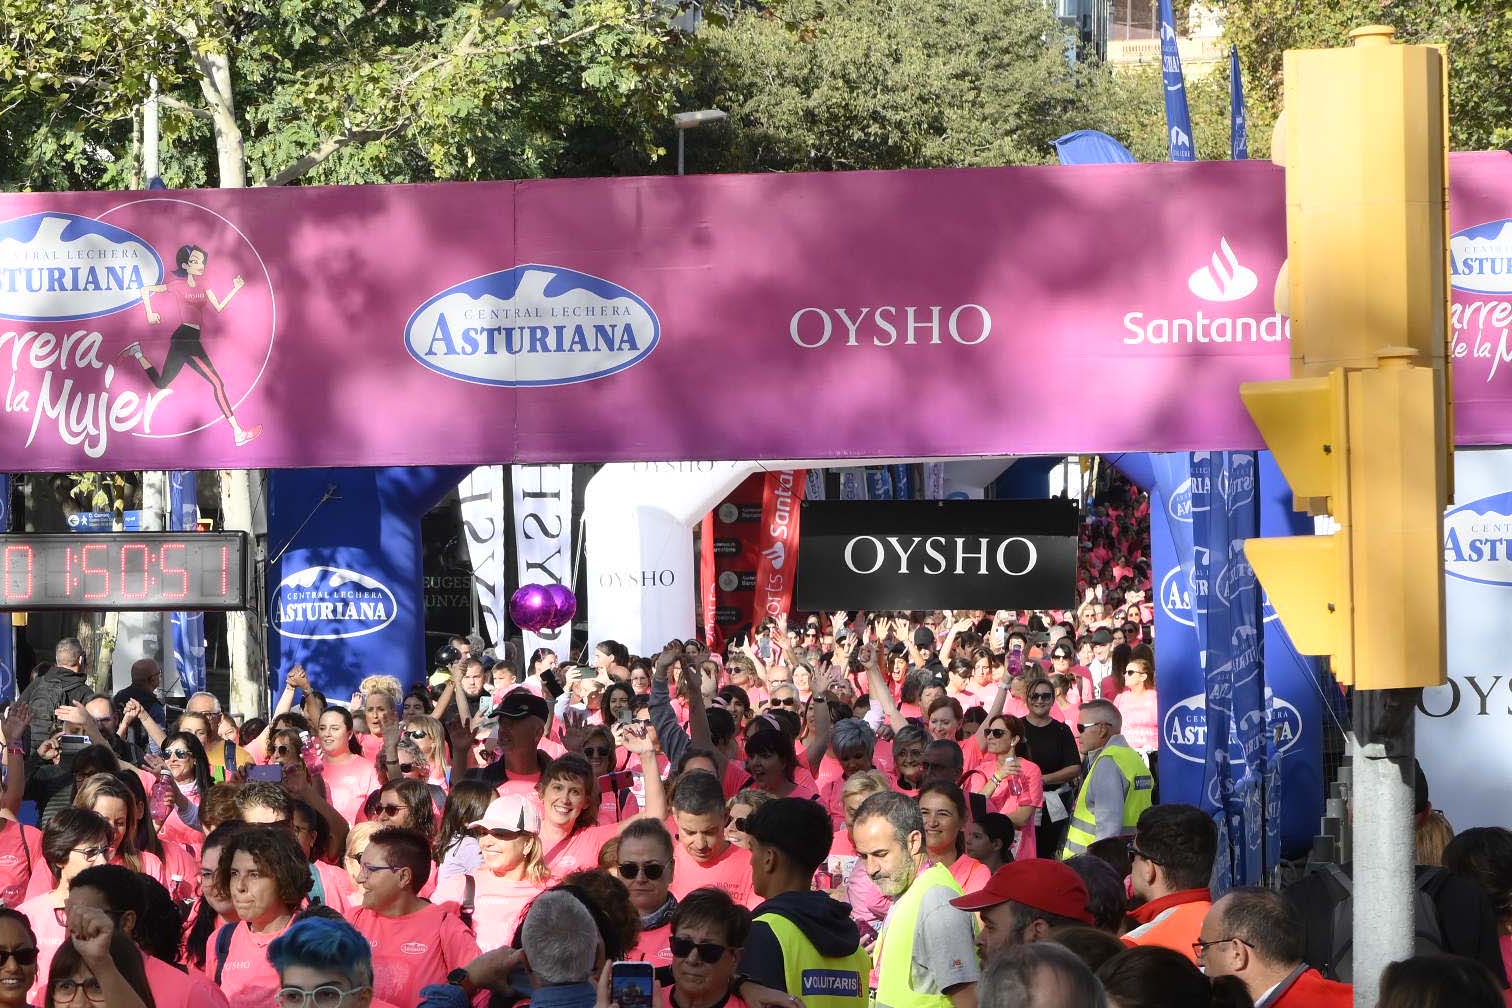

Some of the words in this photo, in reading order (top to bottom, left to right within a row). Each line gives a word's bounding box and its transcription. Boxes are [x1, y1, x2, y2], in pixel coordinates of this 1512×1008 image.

[67, 249, 139, 260] LECHERA
[464, 307, 542, 319] CENTRAL
[552, 305, 632, 318] LECHERA
[425, 313, 640, 357] ASTURIANA
[790, 303, 992, 349] OYSHO
[5, 371, 29, 413] la
[25, 365, 174, 458] Mujer
[844, 535, 1038, 576] OYSHO
[599, 569, 676, 588] OYSHO
[287, 591, 331, 600] CENTRAL
[335, 591, 383, 600] LECHERA
[274, 599, 387, 624] ASTURIANA
